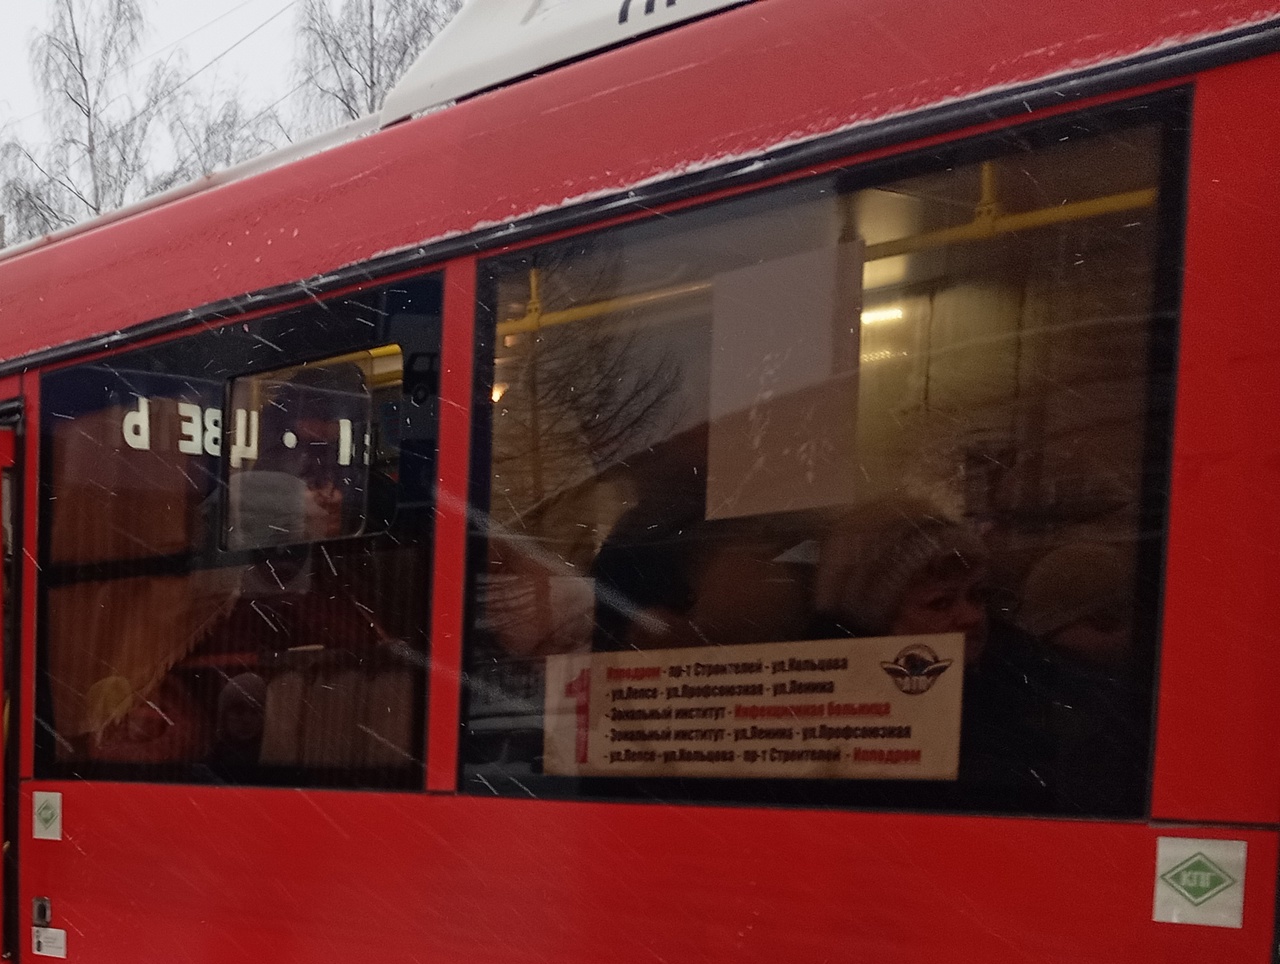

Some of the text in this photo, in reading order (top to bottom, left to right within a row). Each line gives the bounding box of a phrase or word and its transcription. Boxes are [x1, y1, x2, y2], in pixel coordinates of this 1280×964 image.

[694, 659, 763, 676] Строителей
[564, 668, 591, 765] 1
[675, 707, 726, 720] институт
[674, 728, 725, 742] институт
[769, 747, 841, 764] Строителей
